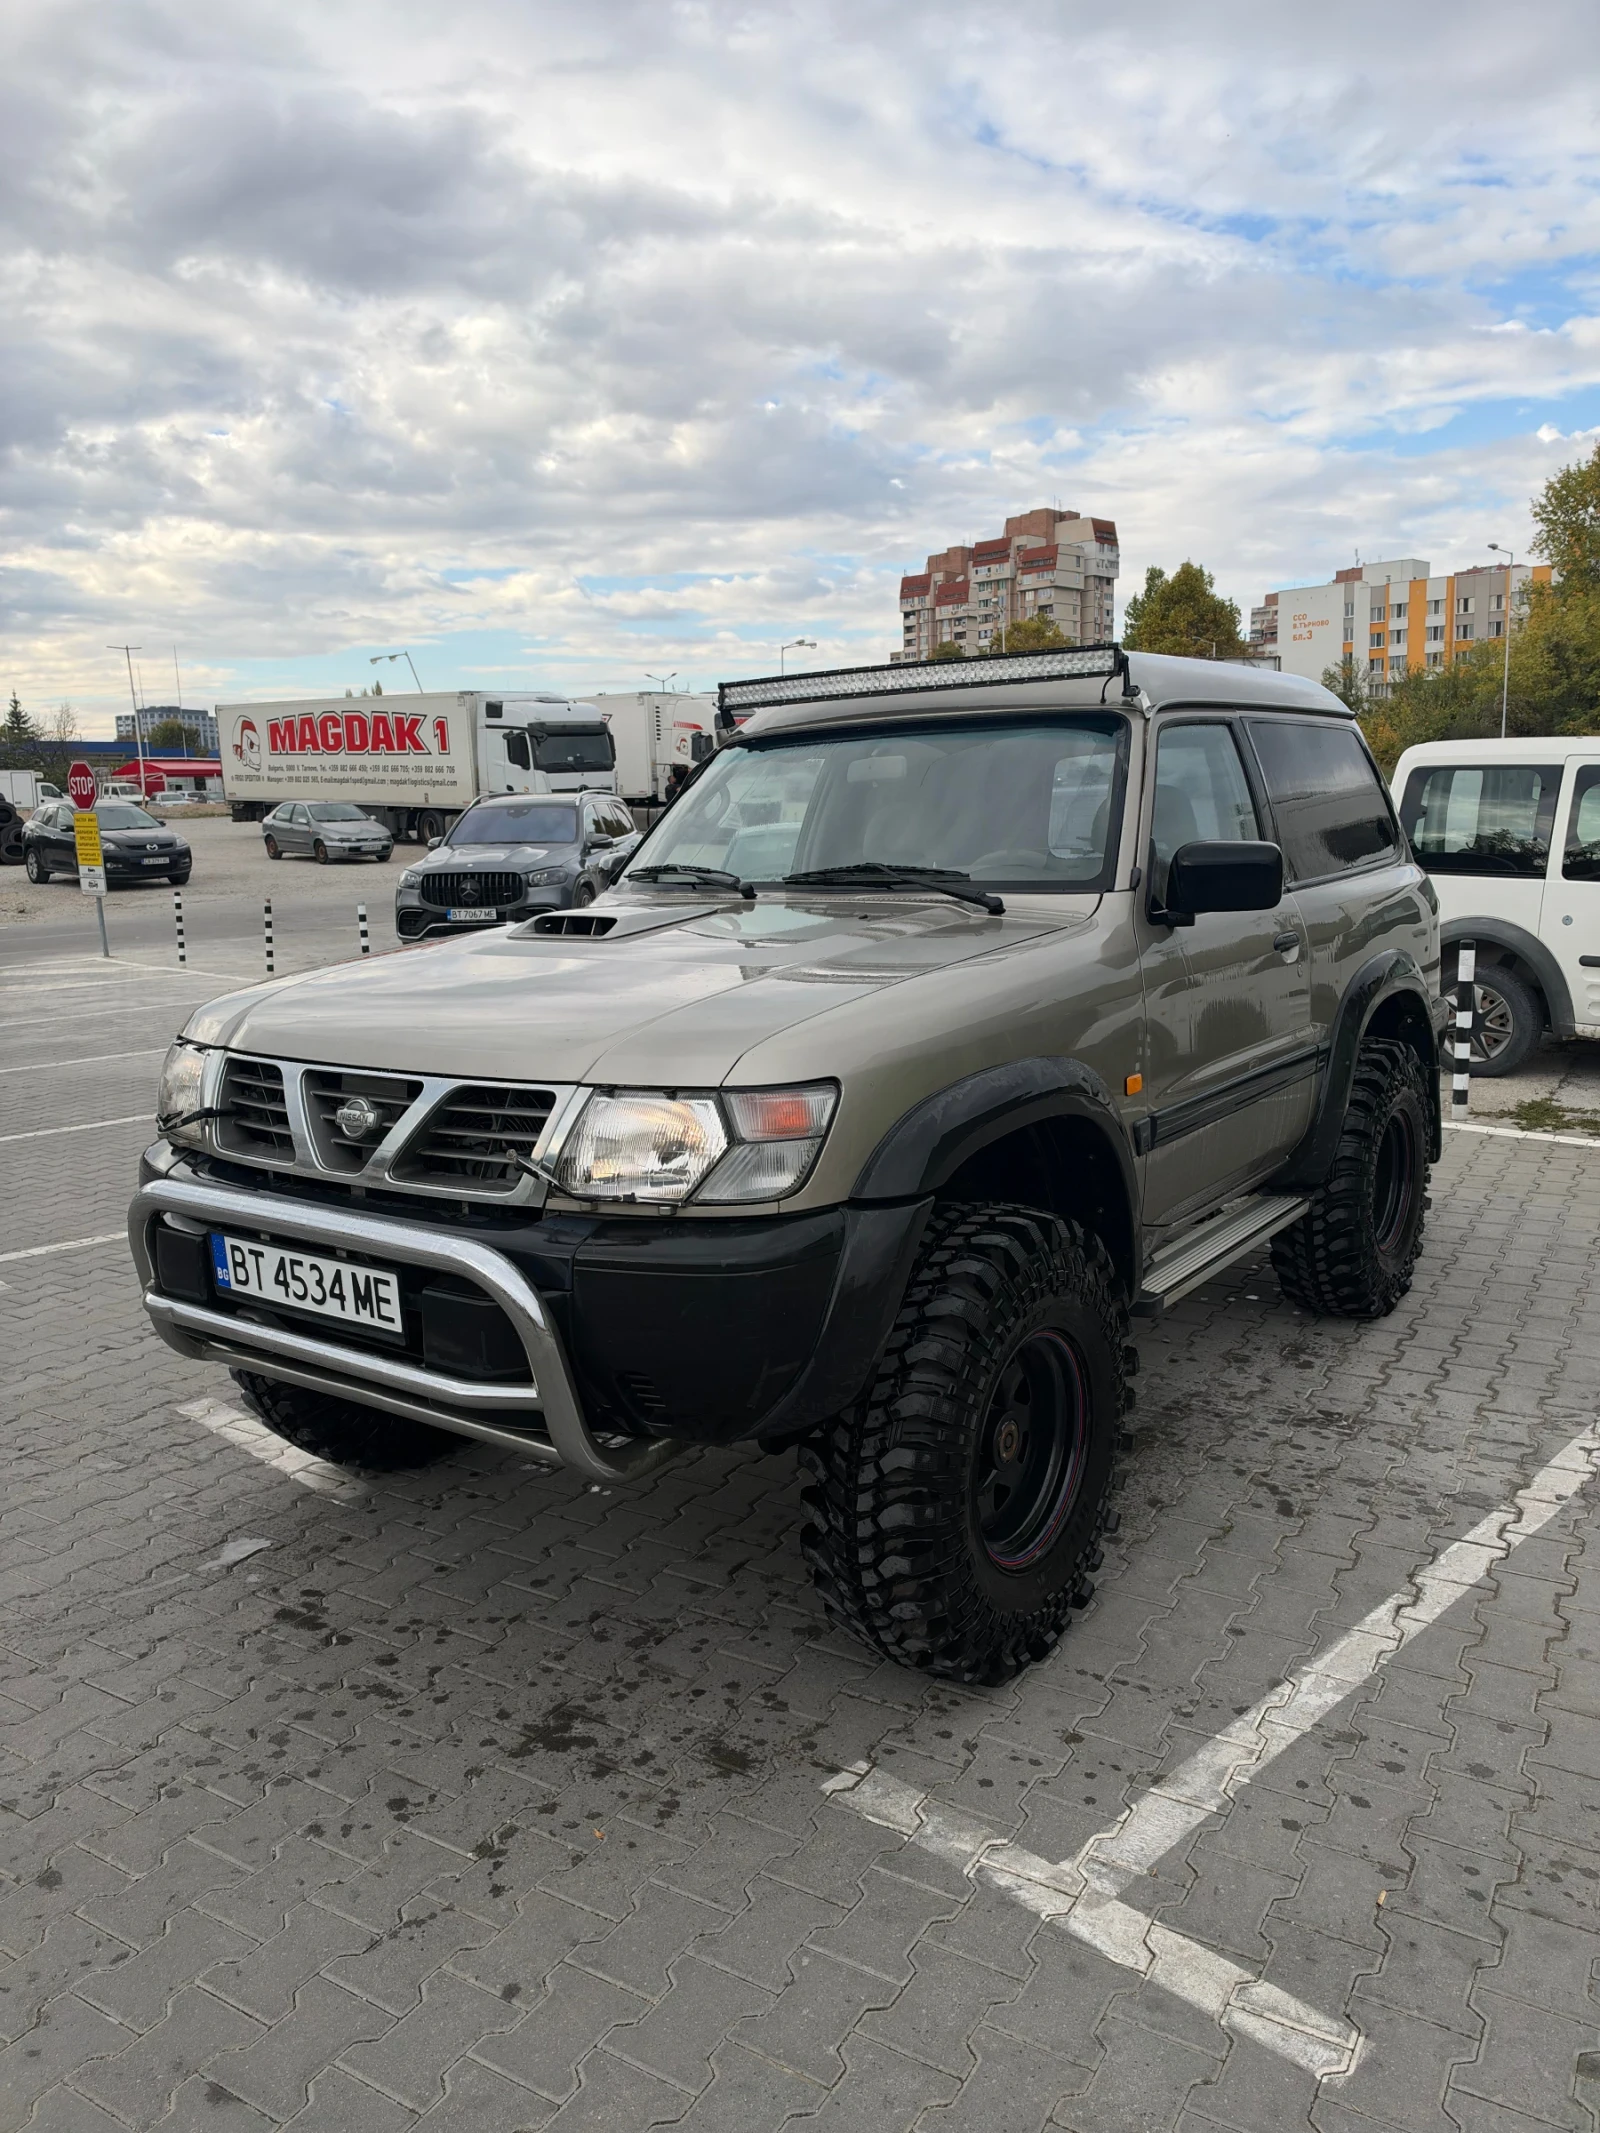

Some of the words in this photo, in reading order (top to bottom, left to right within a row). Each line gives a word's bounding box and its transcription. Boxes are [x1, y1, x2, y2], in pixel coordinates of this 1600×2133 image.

[267, 711, 432, 755] MAGDAK
[433, 716, 450, 755] 1
[71, 777, 93, 795] STOP
[452, 911, 462, 919] BT
[464, 911, 483, 919] 7067
[341, 1112, 368, 1125] NISSAN
[217, 1267, 229, 1280] BG
[230, 1244, 264, 1291] BT
[274, 1256, 346, 1311] 4534
[351, 1271, 395, 1323] ME
